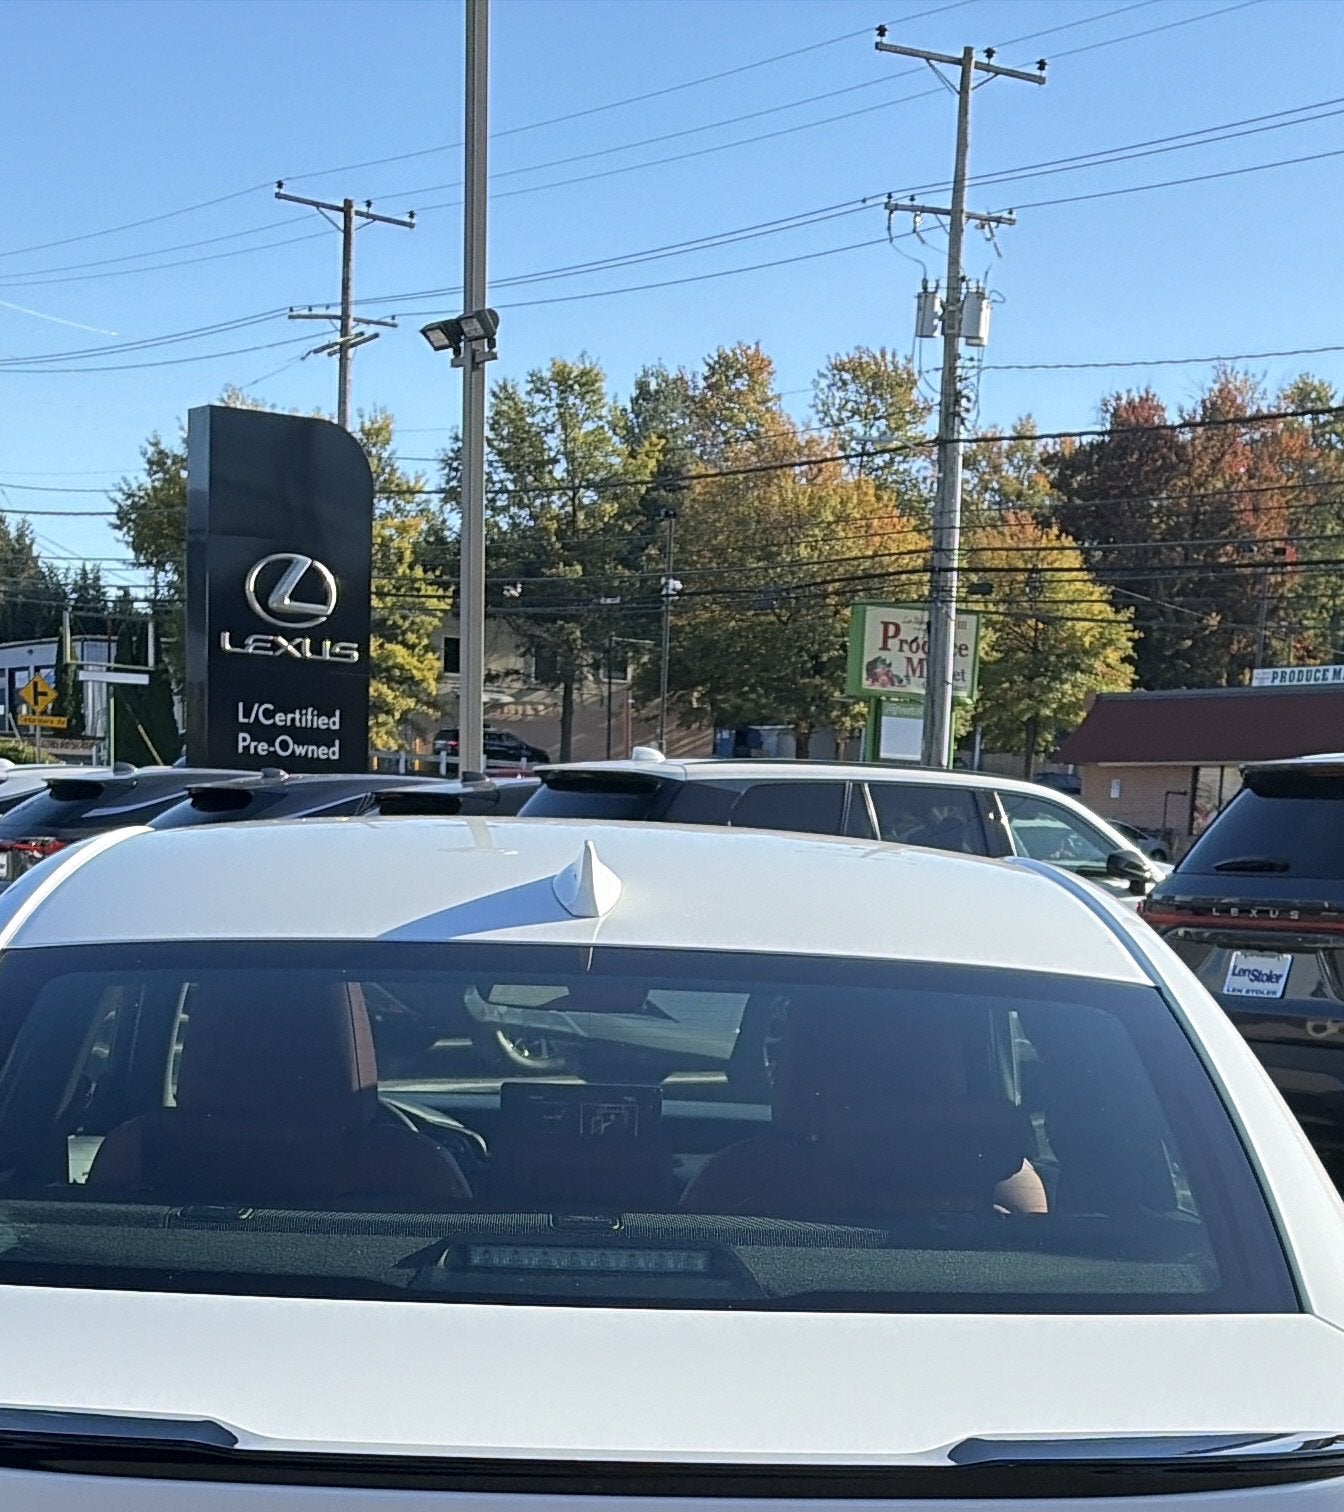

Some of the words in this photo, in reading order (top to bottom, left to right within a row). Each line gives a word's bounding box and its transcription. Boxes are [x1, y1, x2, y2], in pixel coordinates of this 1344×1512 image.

[220, 631, 359, 663] LEXUS
[879, 620, 969, 658] Proe
[905, 656, 967, 682] Met
[1271, 668, 1329, 683] PRODUCE
[238, 701, 341, 730] L/Certified
[237, 732, 341, 760] Pre-Owned
[1212, 907, 1300, 919] LEXUS
